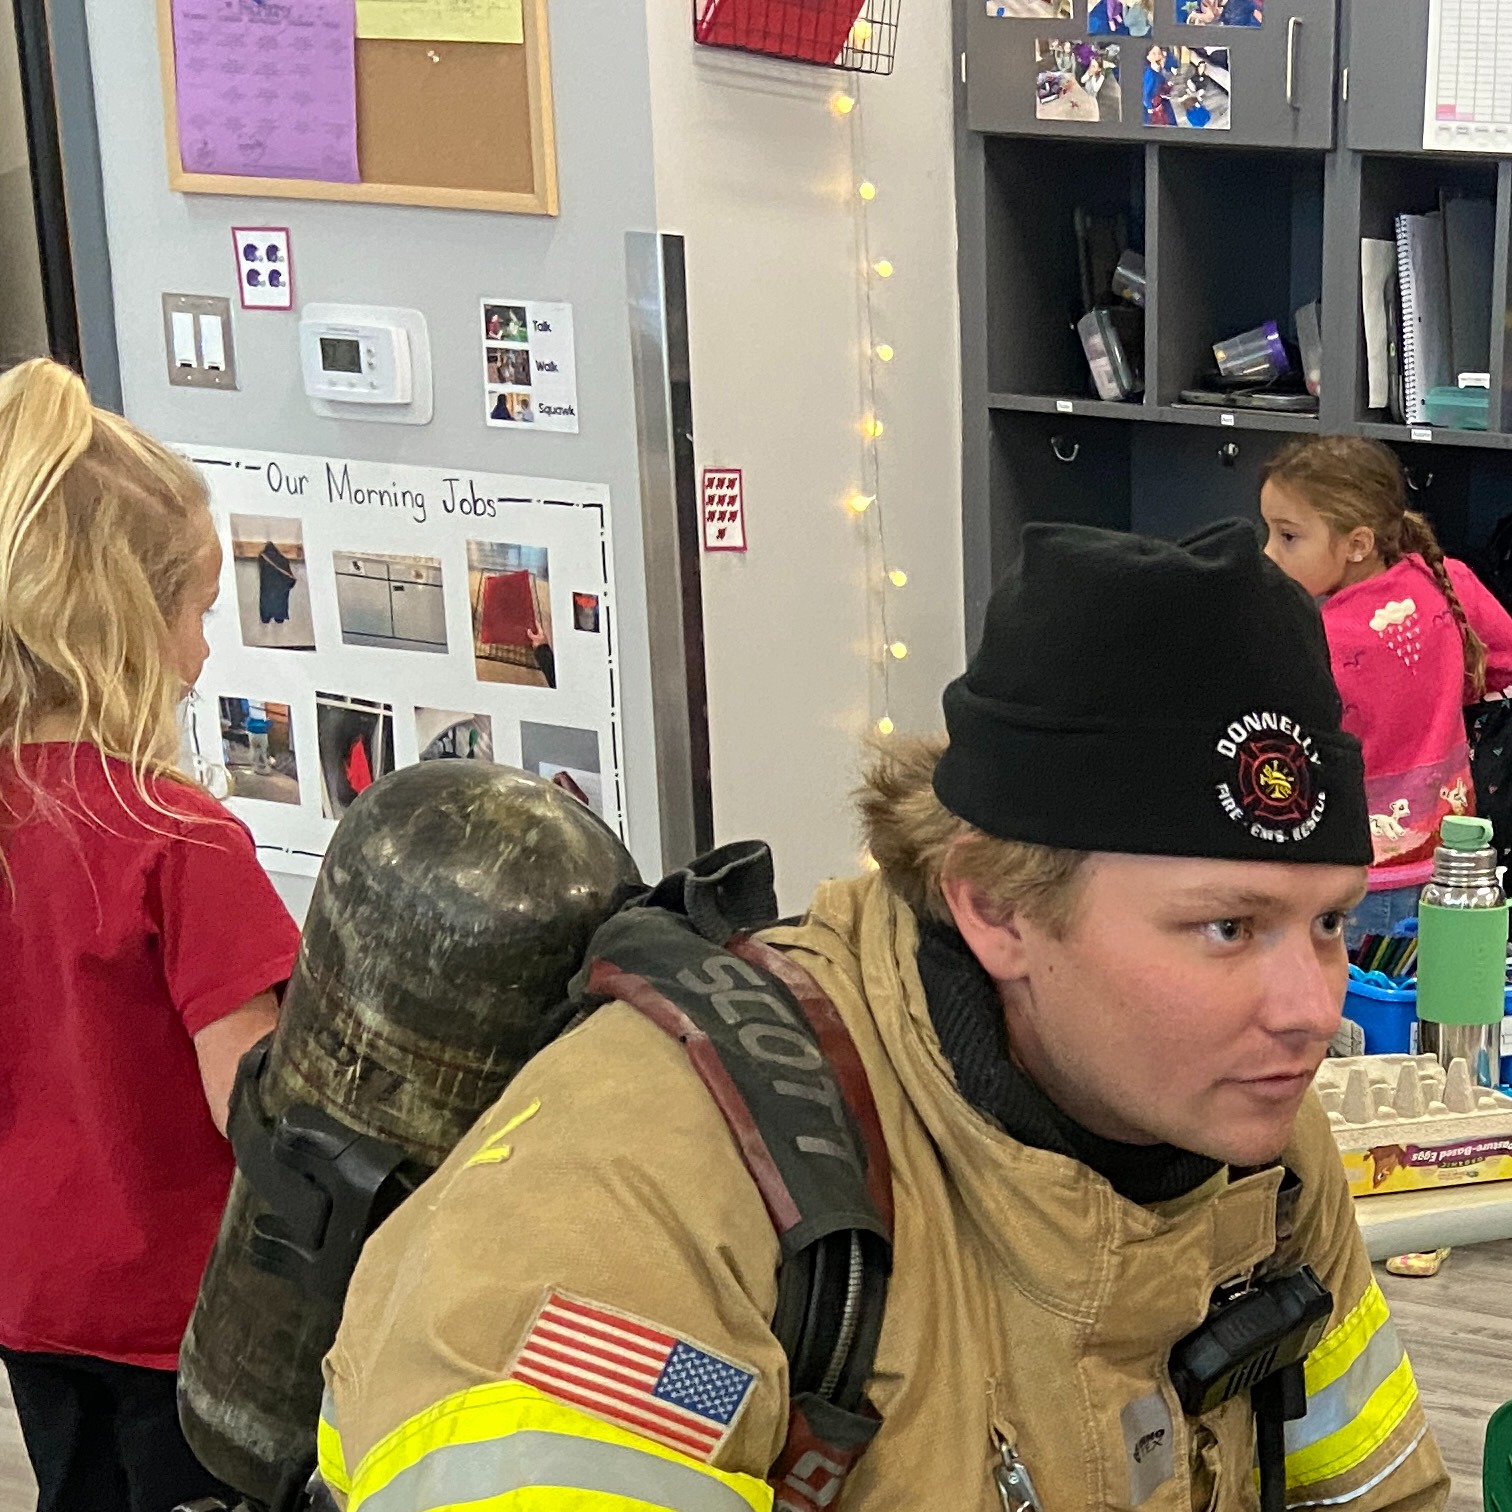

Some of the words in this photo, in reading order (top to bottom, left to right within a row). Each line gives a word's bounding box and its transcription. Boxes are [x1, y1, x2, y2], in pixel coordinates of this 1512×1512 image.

[532, 319, 552, 333] Talk
[535, 360, 559, 373] Walk
[538, 403, 576, 418] Squawk
[267, 462, 309, 495] Our
[325, 462, 427, 523] Morning
[442, 478, 497, 518] Jobs
[1216, 711, 1322, 766] DONNELLY
[1215, 783, 1244, 821] FIRE
[676, 955, 863, 1180] SCOTT
[1411, 1150, 1437, 1163] Eggs
